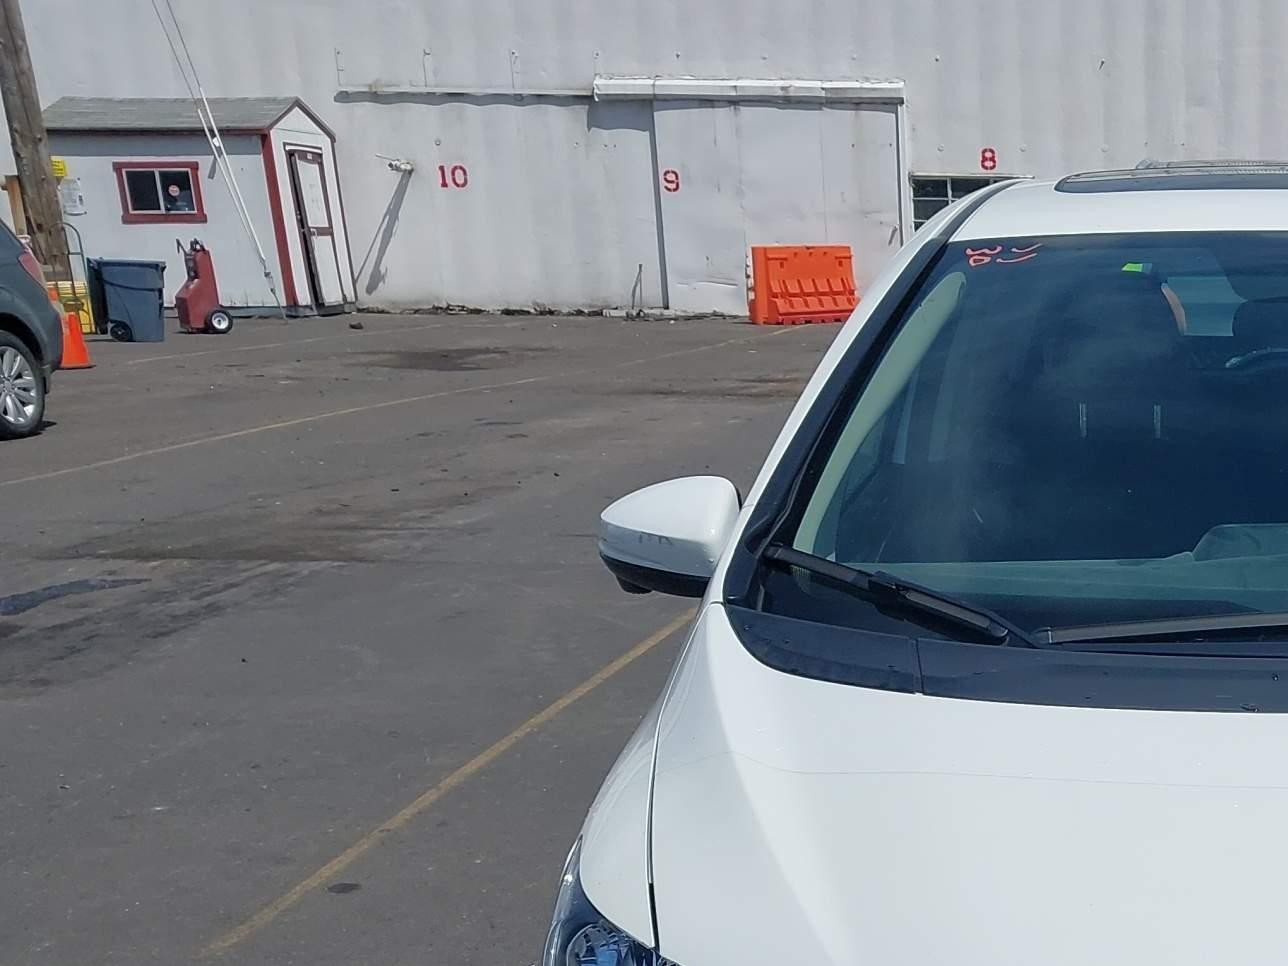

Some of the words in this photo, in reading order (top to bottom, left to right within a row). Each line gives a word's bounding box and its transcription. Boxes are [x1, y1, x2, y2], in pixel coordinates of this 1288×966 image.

[981, 148, 997, 170] 8
[438, 165, 468, 188] 10
[663, 169, 680, 193] 9
